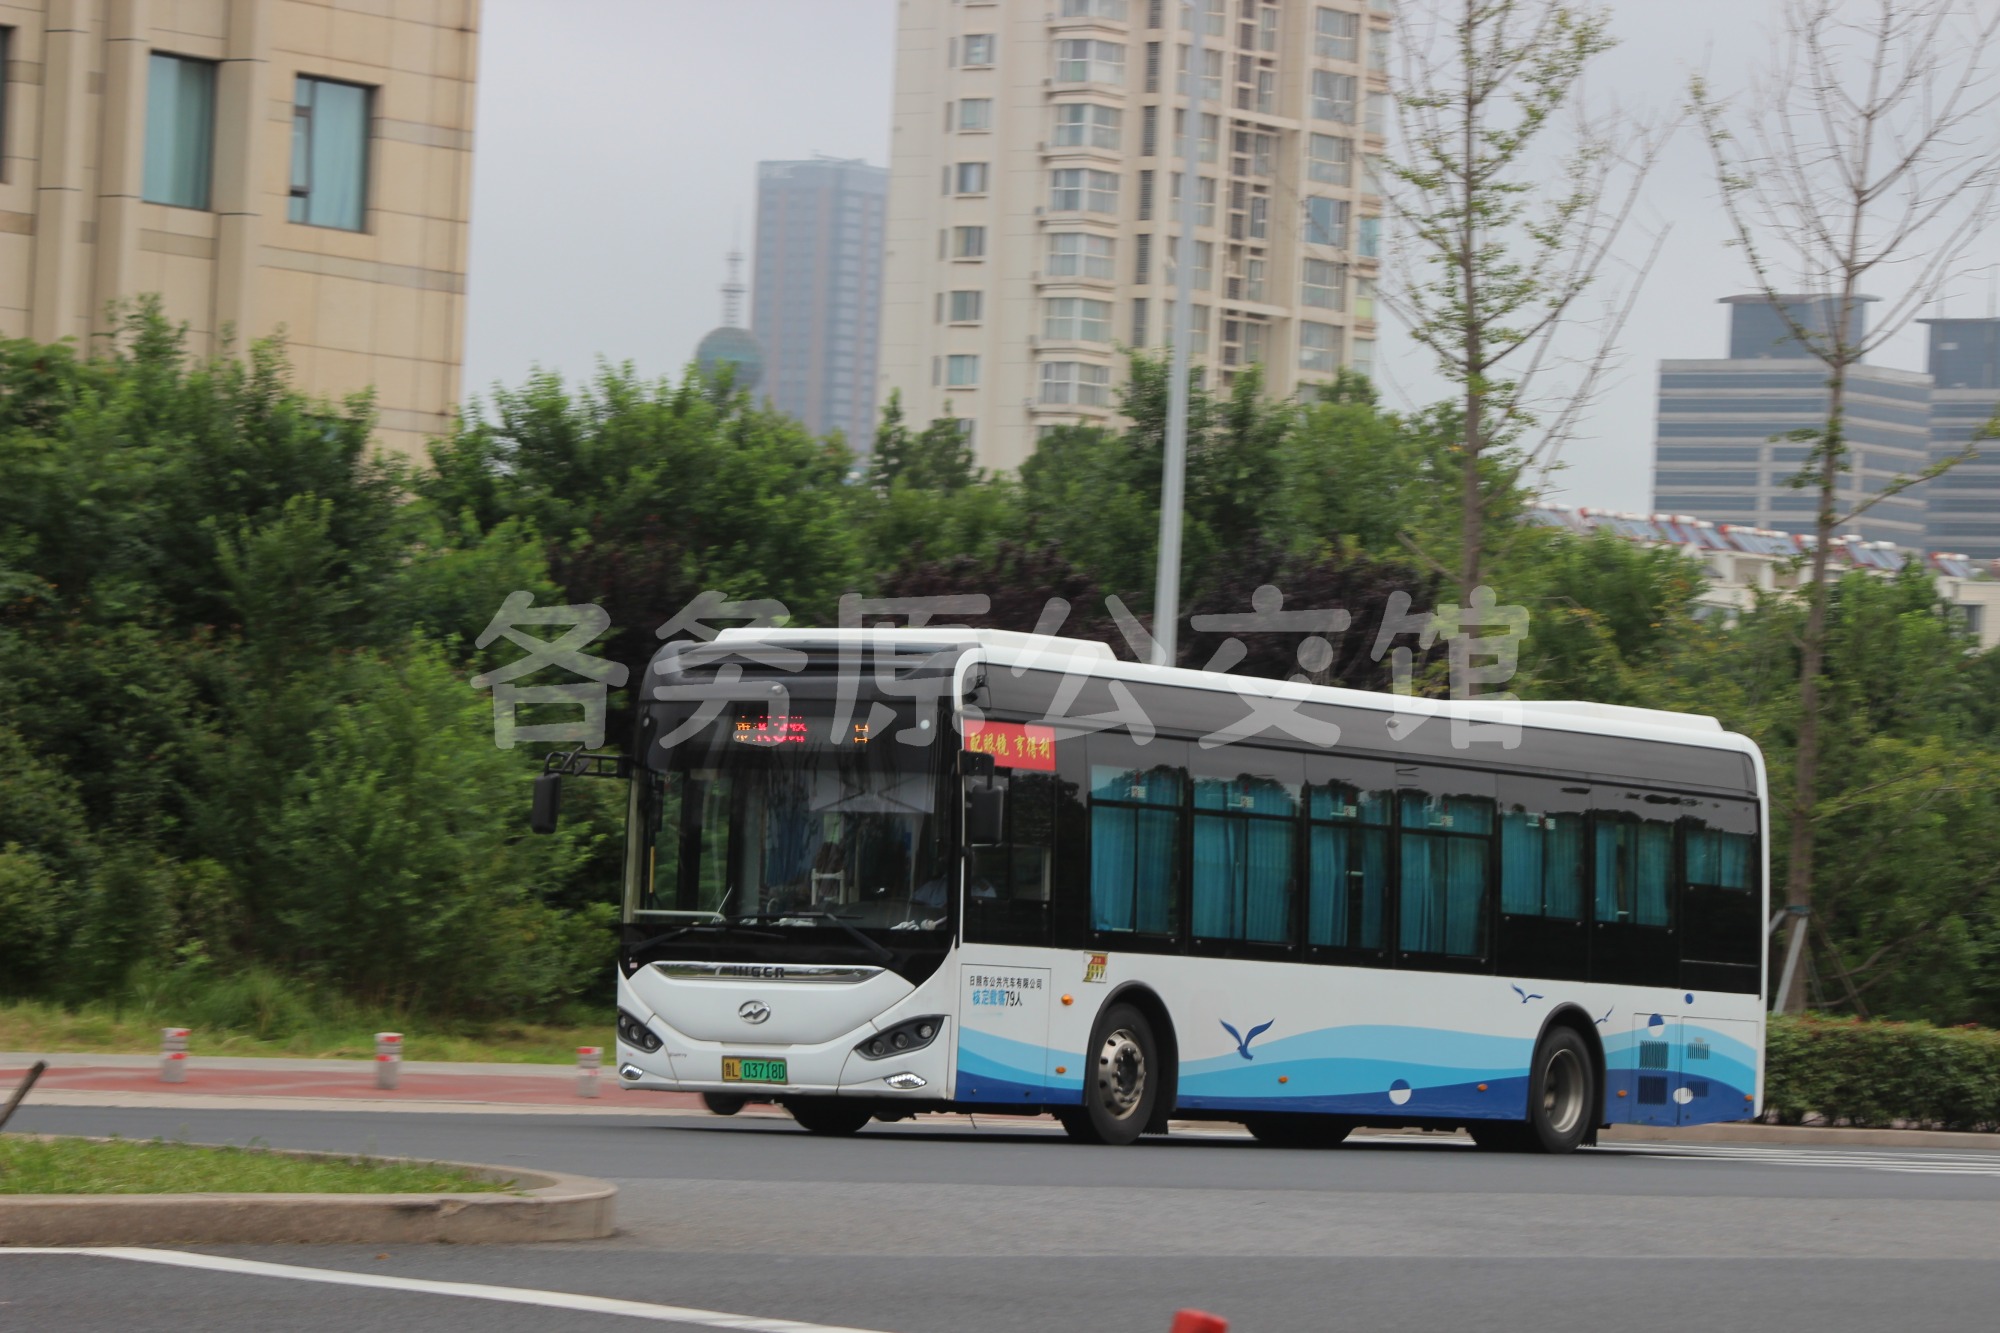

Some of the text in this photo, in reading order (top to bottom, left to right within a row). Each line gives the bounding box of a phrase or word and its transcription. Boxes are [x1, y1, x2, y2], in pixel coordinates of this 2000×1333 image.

[969, 732, 1050, 759] 配眼镜 亨得利
[969, 975, 1043, 989] 日照市公共汽车有限公司
